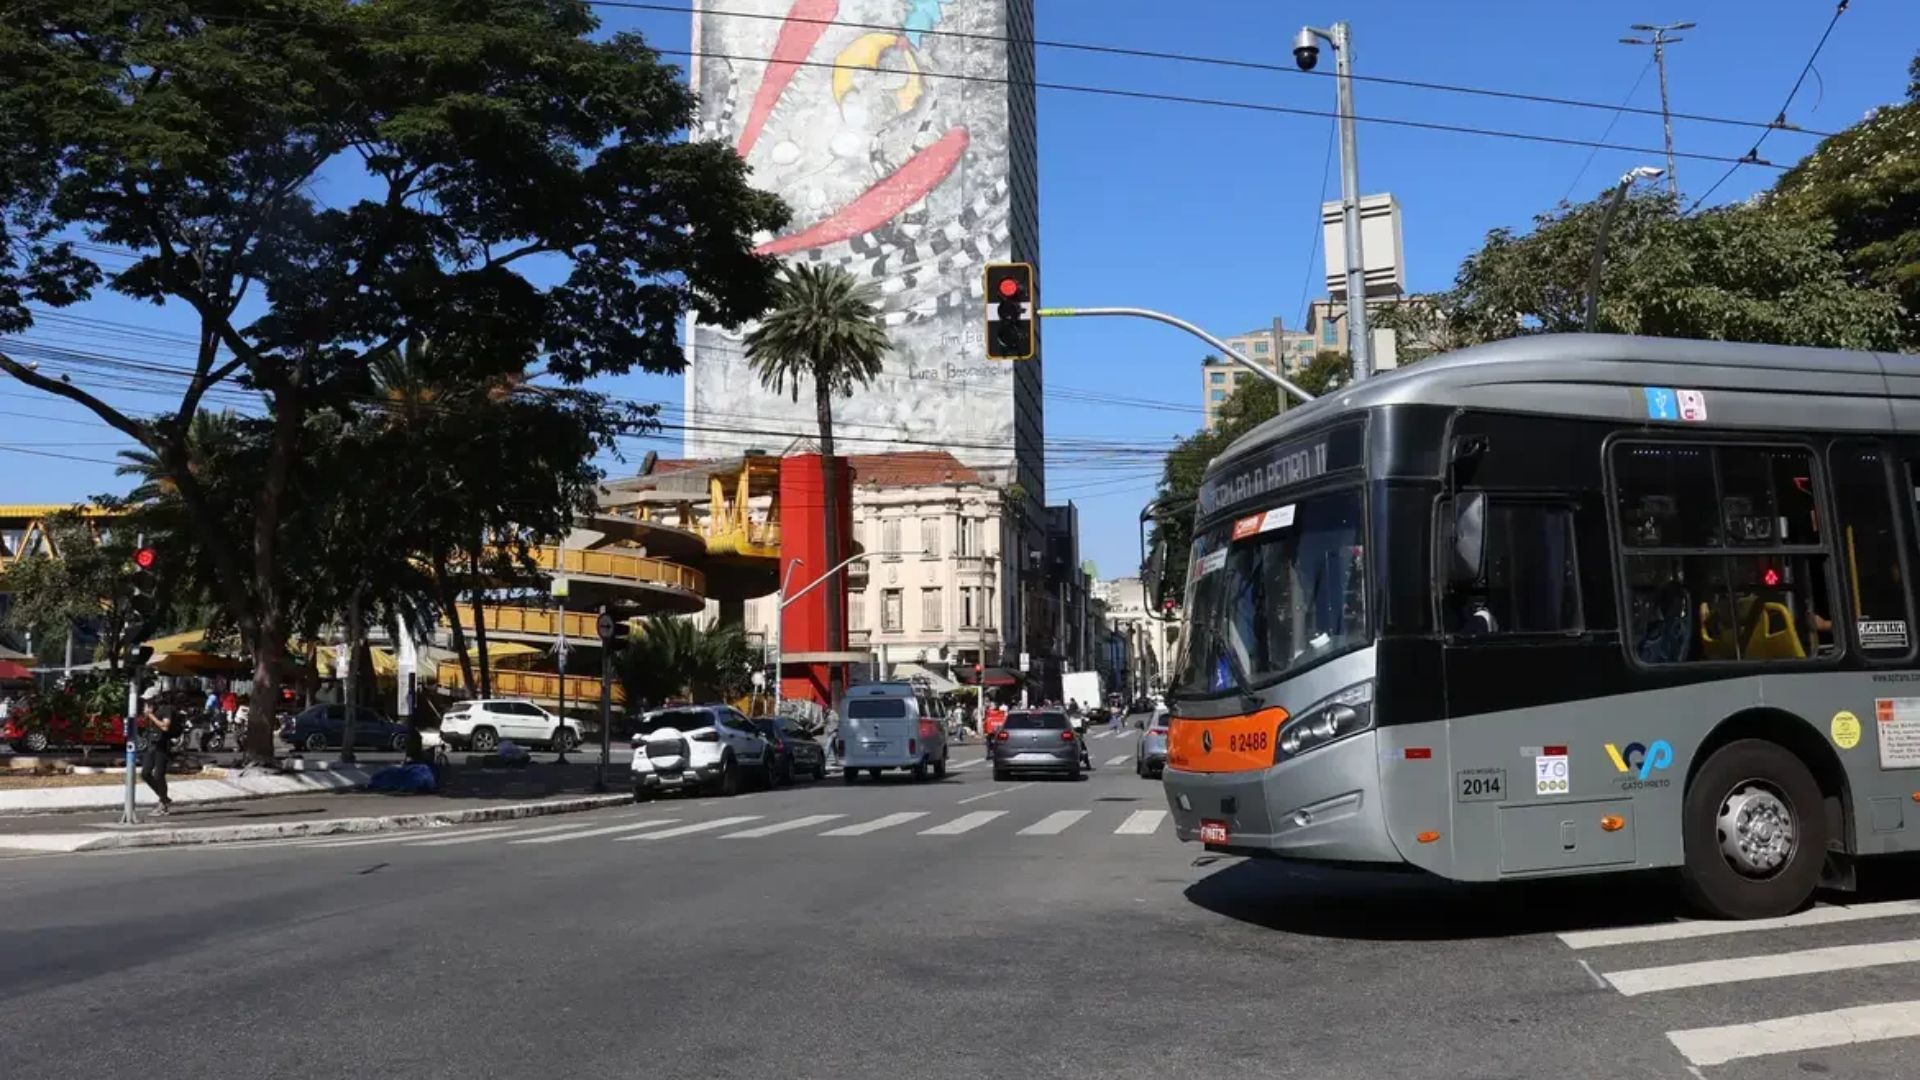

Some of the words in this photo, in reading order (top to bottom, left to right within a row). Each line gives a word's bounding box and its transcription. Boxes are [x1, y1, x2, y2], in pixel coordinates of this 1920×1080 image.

[1230, 734, 1236, 752] 8
[1239, 731, 1267, 752] 2488
[1463, 777, 1501, 796] 2014
